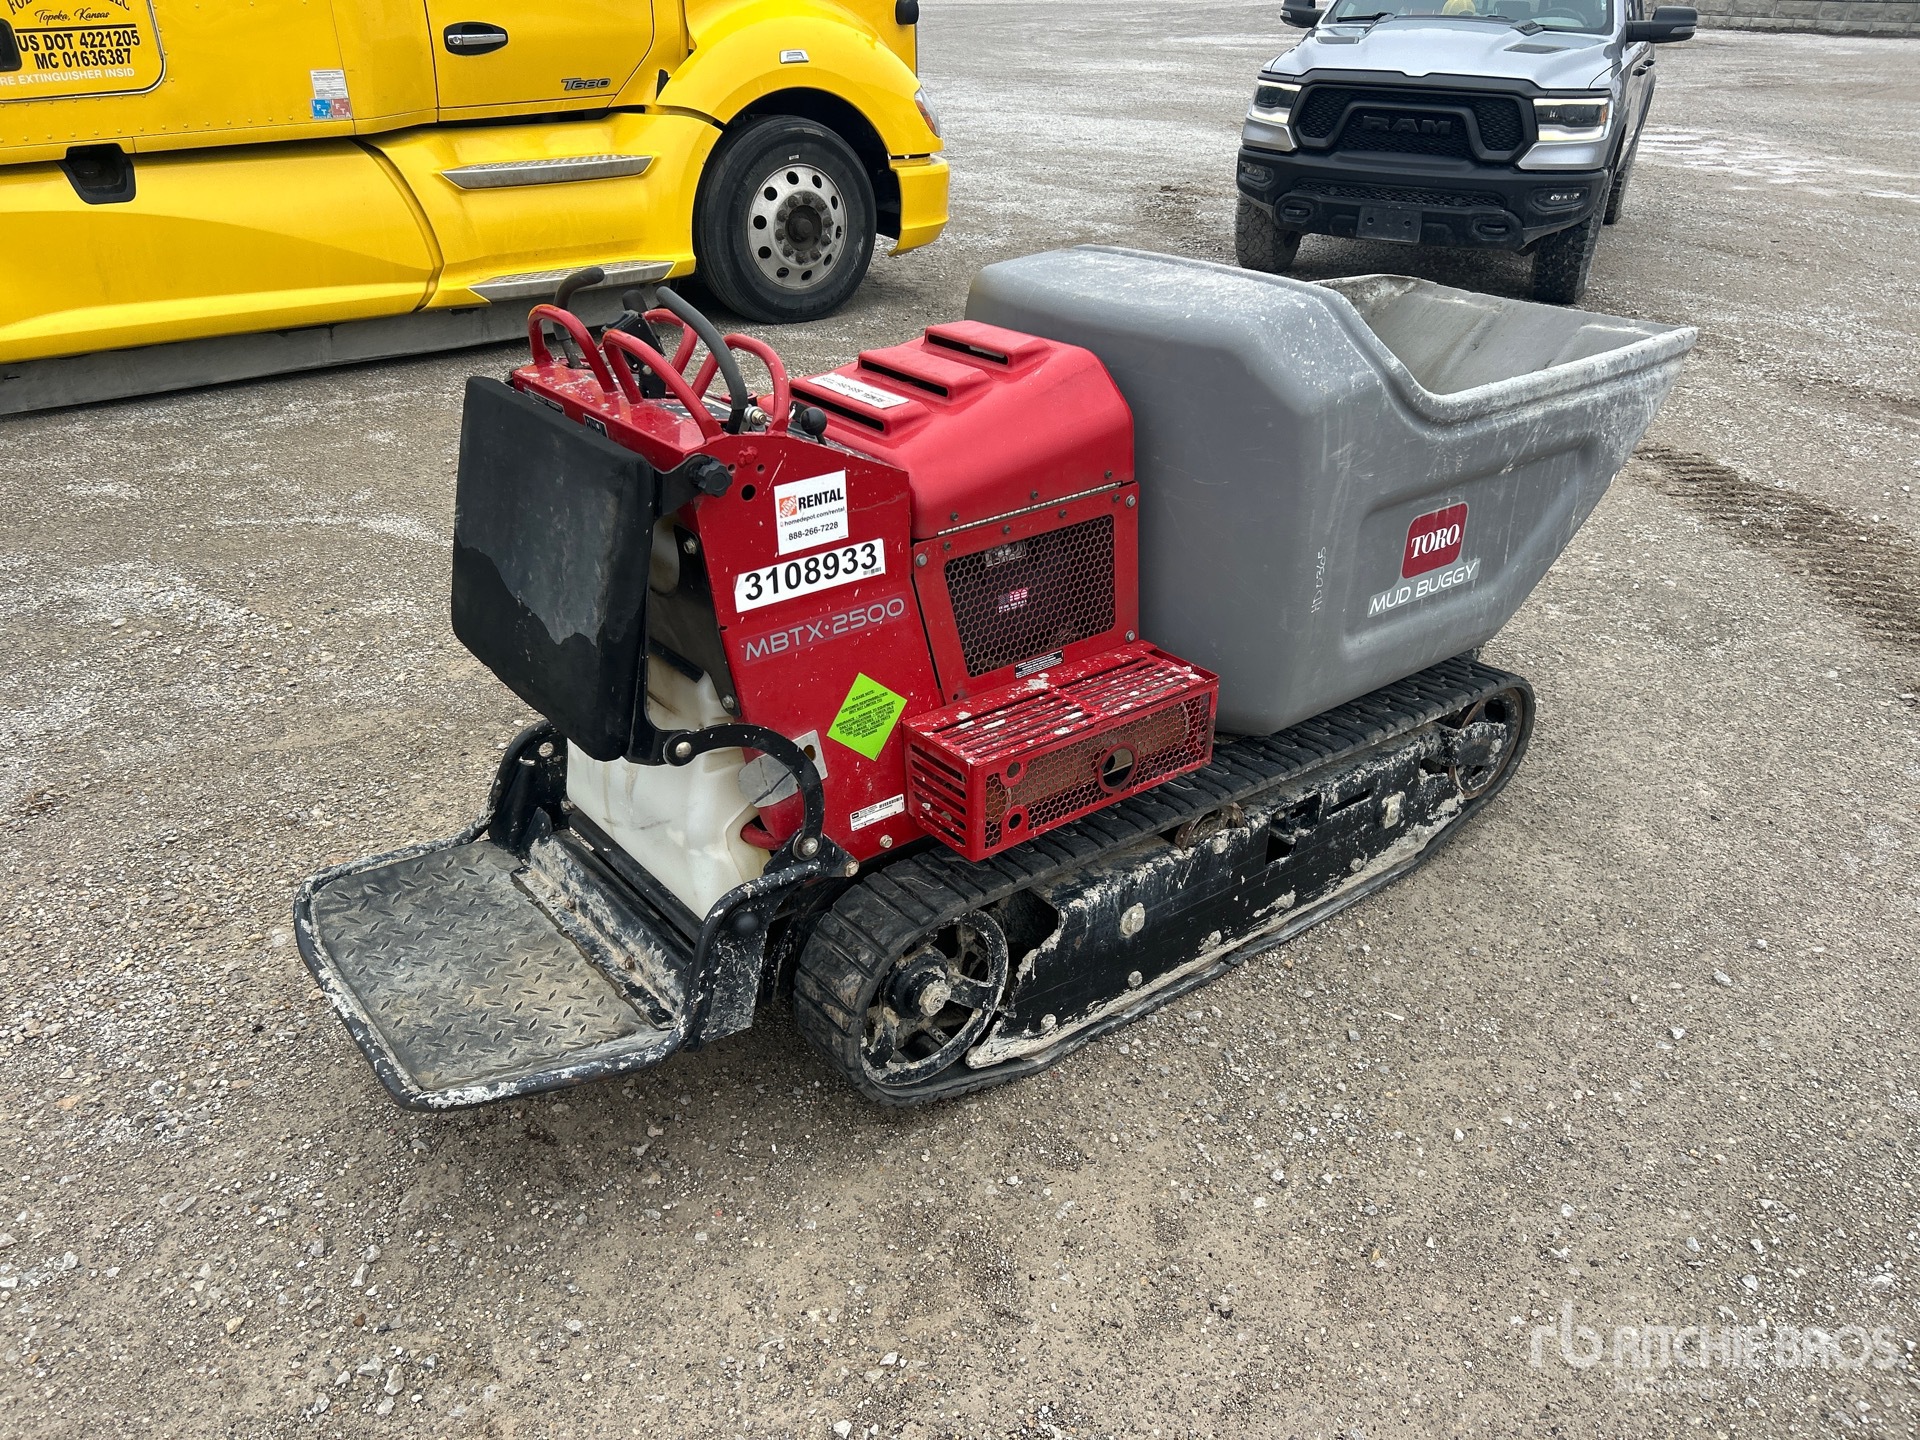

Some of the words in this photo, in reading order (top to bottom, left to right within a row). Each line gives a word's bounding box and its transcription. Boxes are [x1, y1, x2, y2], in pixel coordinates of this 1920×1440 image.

[34, 9, 71, 26] Topeka,
[74, 7, 111, 22] Kansas
[16, 34, 40, 52] US
[43, 33, 74, 51] DOT
[79, 30, 141, 49] 4221205
[34, 52, 60, 70] MC
[62, 48, 132, 69] 01636387
[18, 70, 103, 84] EXTINGUISHER
[561, 77, 612, 91] T680
[1362, 115, 1452, 135] RAM
[798, 488, 844, 510] RENTAL
[784, 506, 846, 527] homedepot.com/rental
[788, 521, 839, 541] 888-266-7228
[1410, 523, 1461, 559] TORO
[744, 543, 878, 600] 3108933
[1369, 586, 1412, 616] MUD
[1415, 562, 1479, 598] BUGGY
